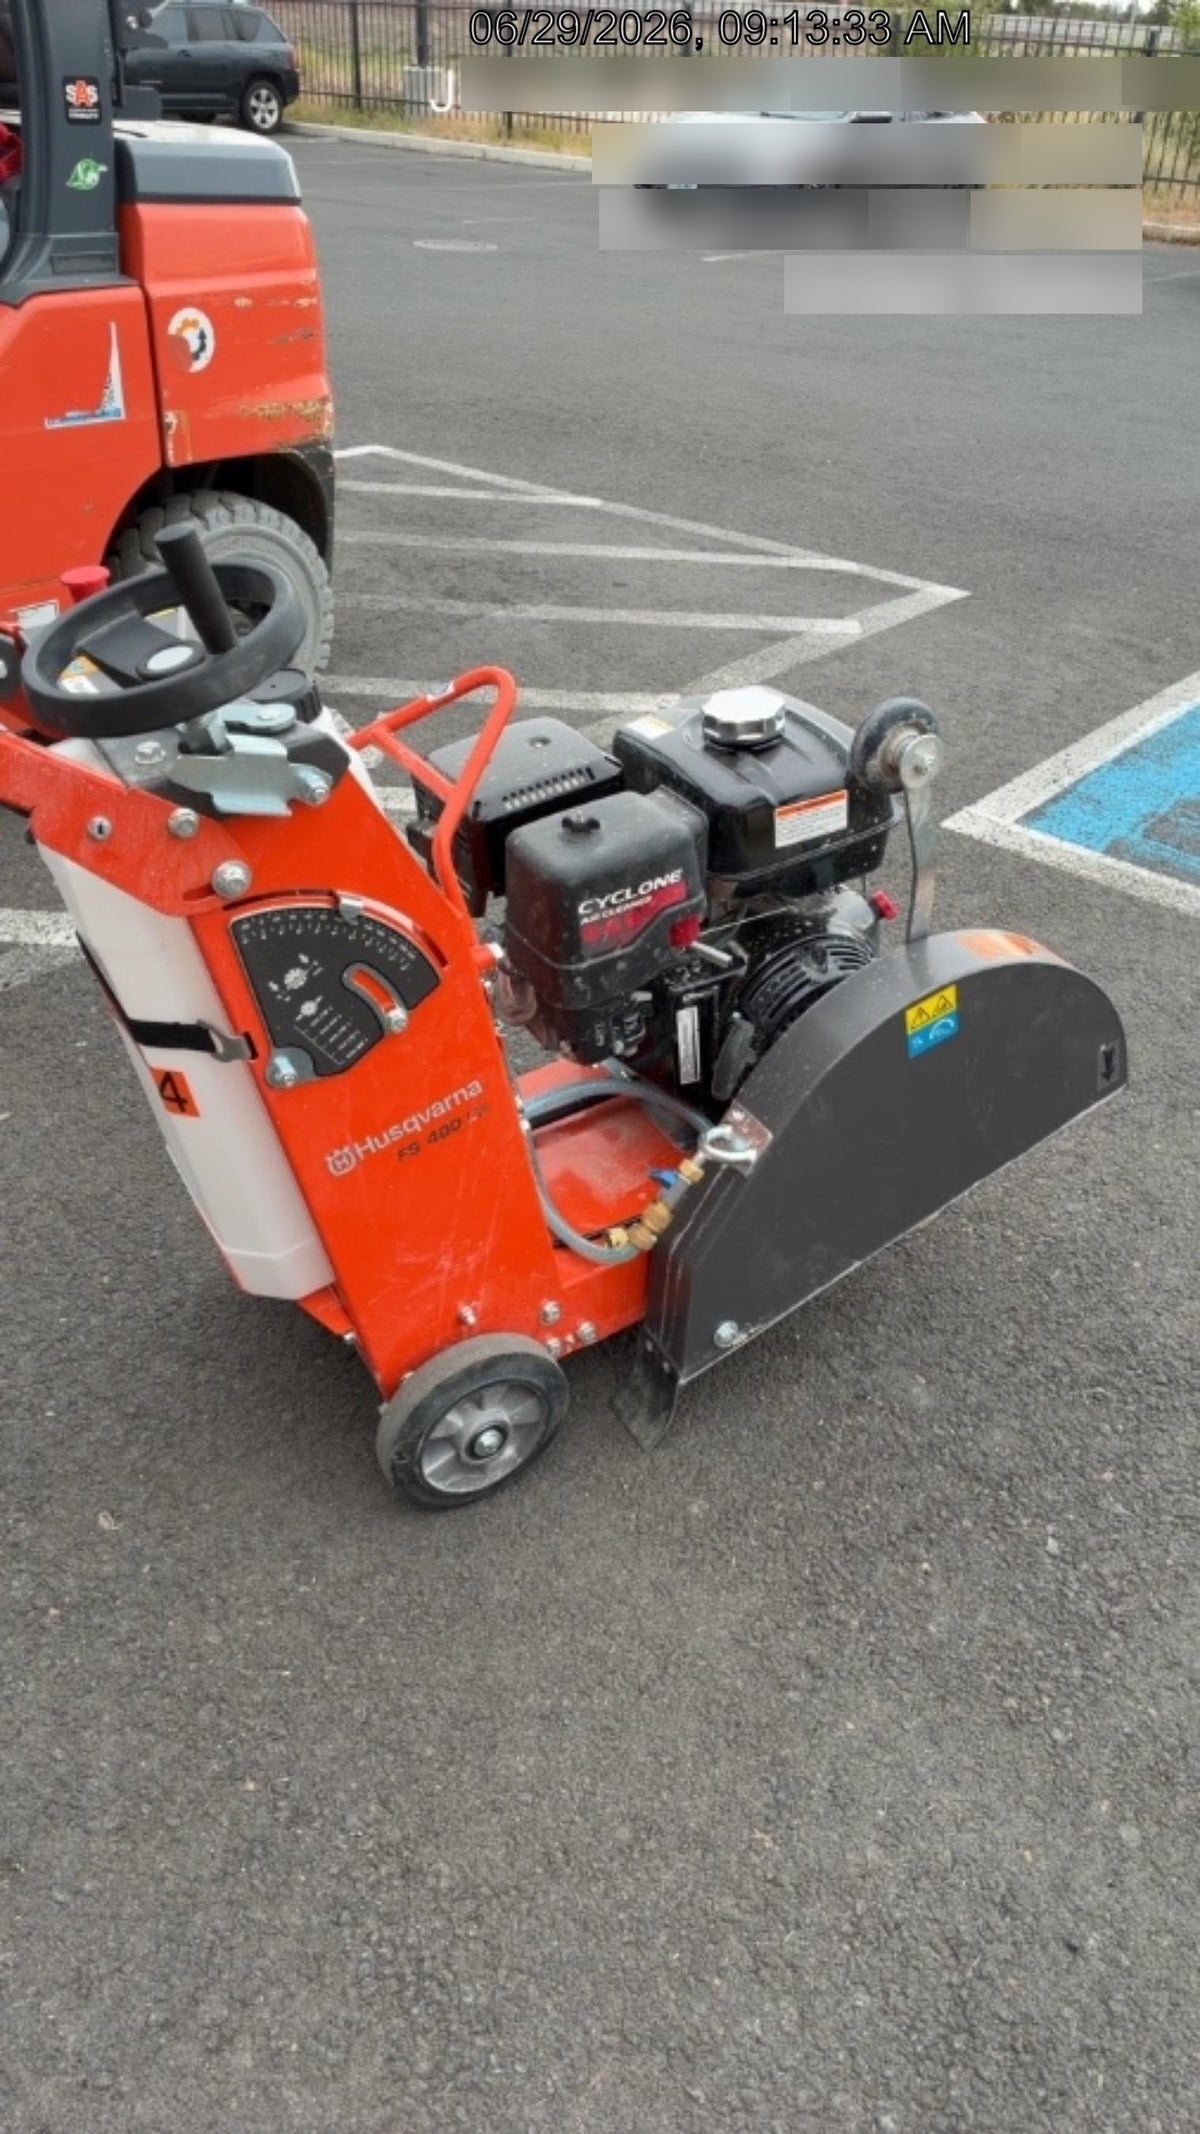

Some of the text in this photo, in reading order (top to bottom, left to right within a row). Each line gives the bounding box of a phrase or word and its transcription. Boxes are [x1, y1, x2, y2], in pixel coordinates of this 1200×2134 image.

[578, 866, 684, 914] CYCLONE
[159, 1071, 188, 1113] 4
[354, 1079, 483, 1161] Husqvarna
[426, 1117, 462, 1144] 400
